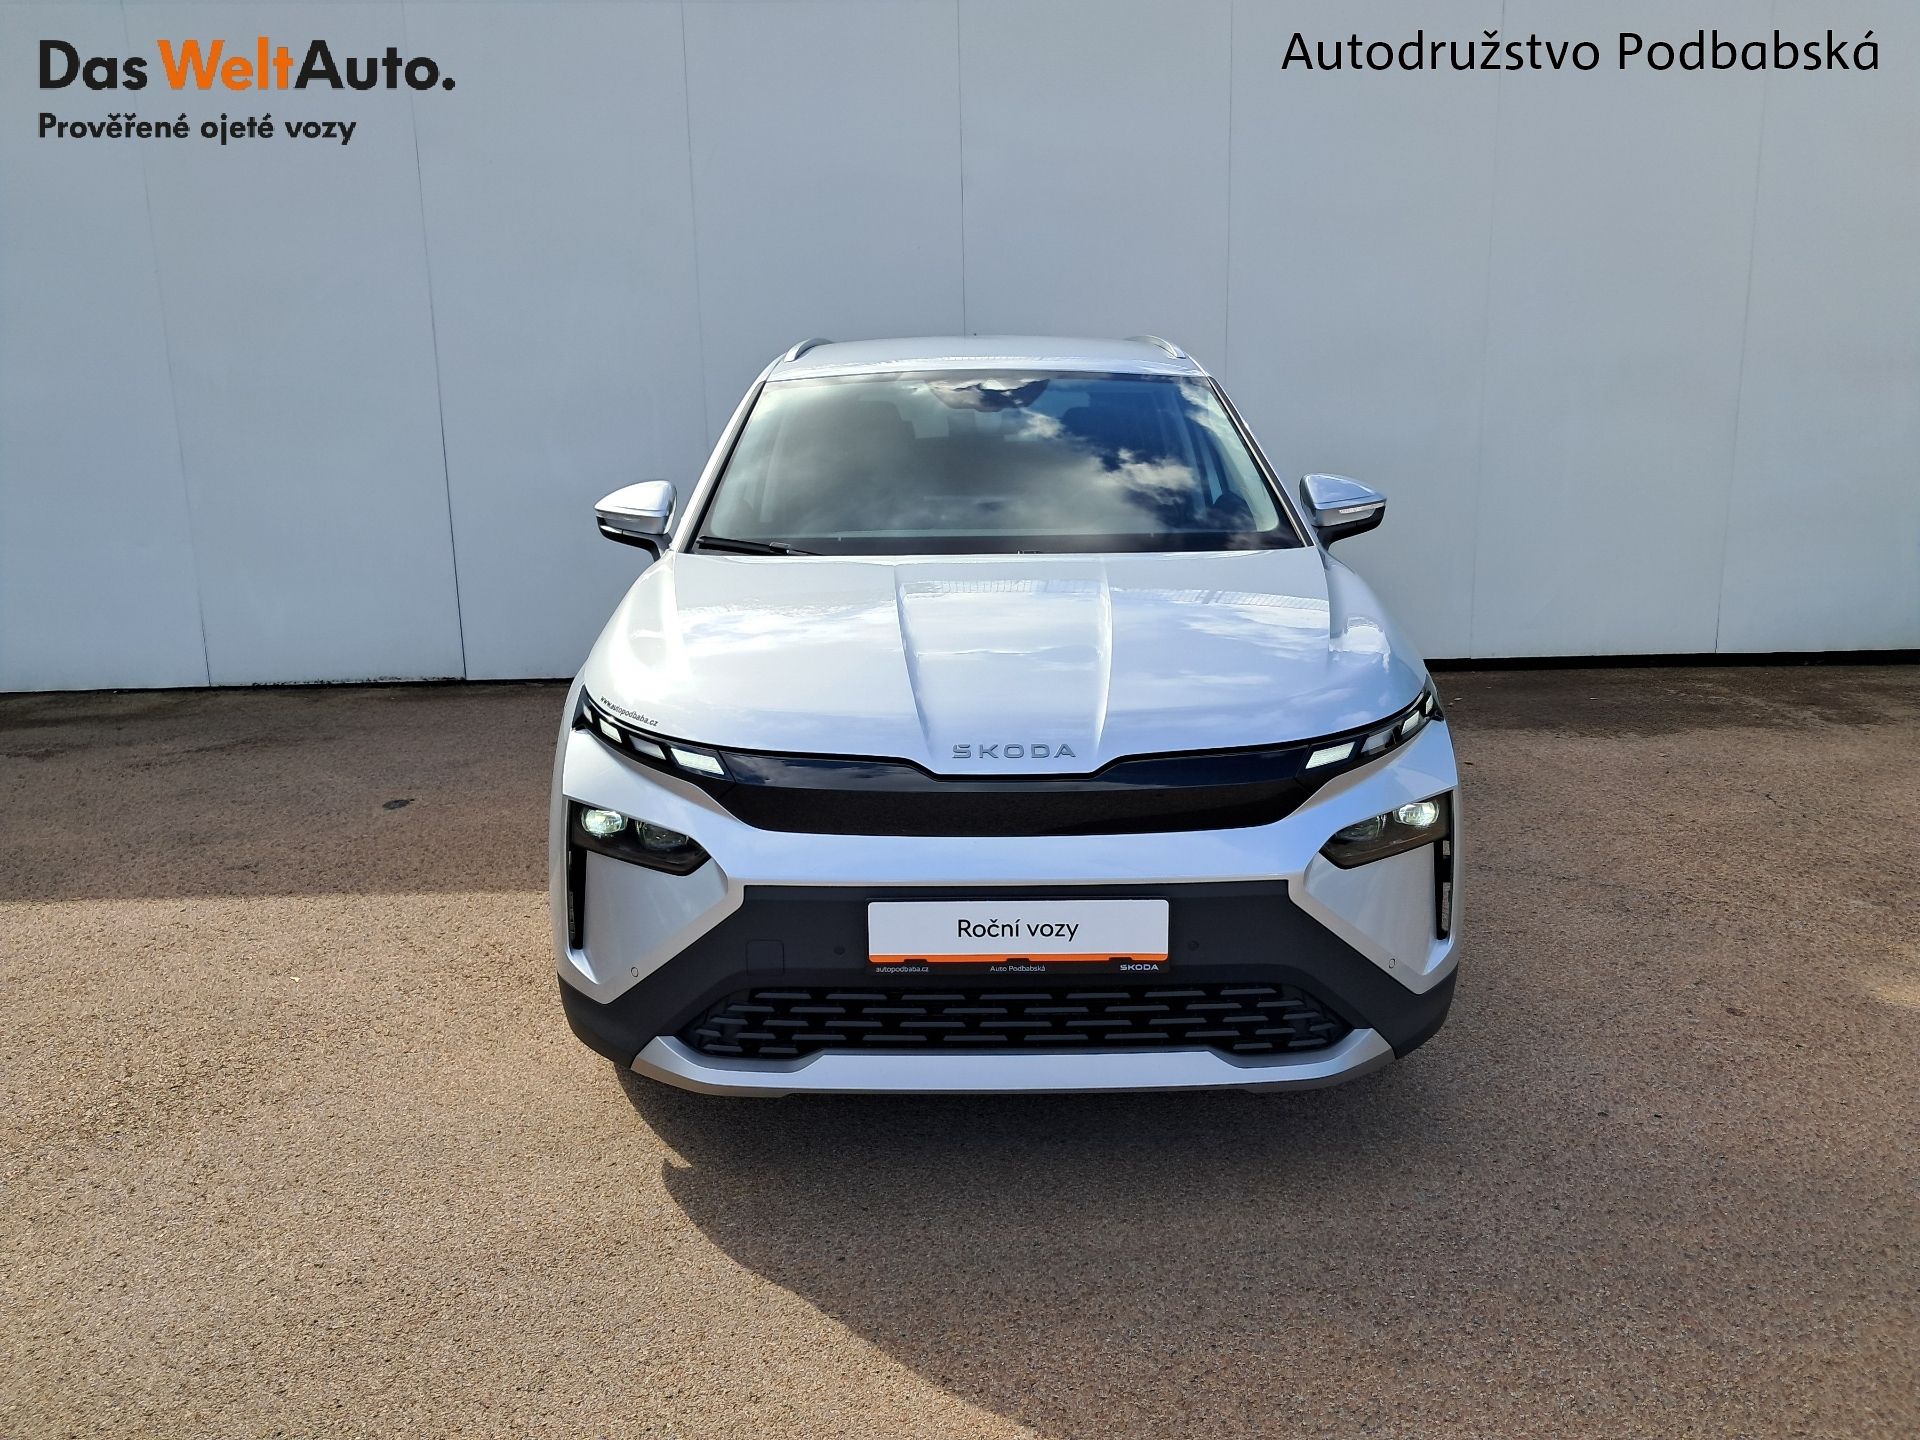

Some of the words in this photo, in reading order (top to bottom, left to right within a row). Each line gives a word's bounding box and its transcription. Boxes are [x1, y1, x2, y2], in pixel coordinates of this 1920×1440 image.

[957, 918, 1020, 938] Roční
[1027, 923, 1079, 942] vozy
[875, 965, 929, 974] autopodbaba.cz
[989, 964, 1006, 973] Auto
[1008, 964, 1046, 973] Podbabská
